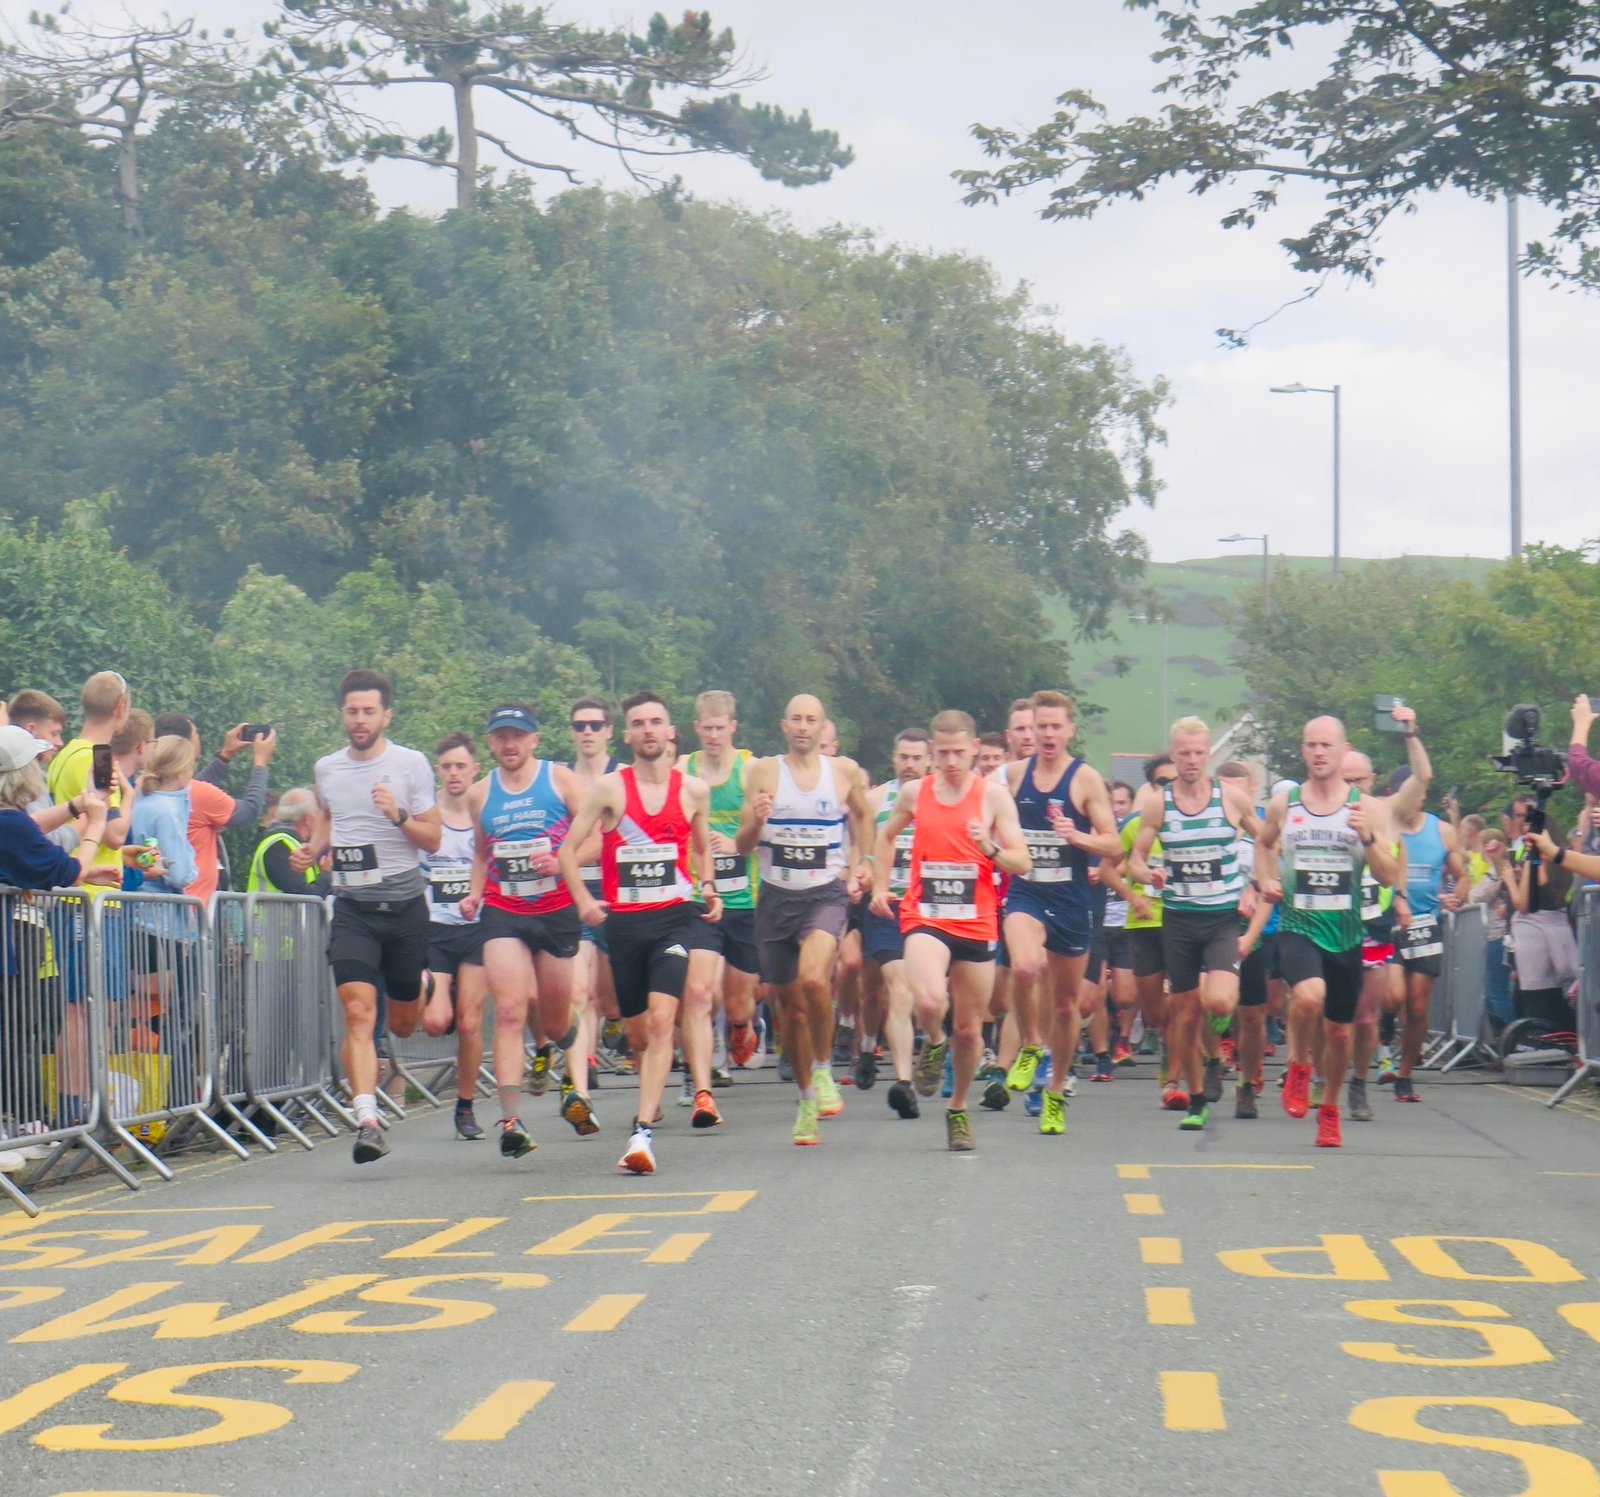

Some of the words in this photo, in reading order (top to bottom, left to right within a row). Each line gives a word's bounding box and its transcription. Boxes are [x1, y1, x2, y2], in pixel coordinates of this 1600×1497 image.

[336, 848, 364, 862] 410
[783, 847, 816, 860] 545
[1029, 846, 1060, 860] 346
[630, 863, 666, 878] 446
[714, 858, 736, 871] 89
[1181, 862, 1212, 875] 442
[1307, 872, 1340, 887] 232
[441, 882, 471, 895] 492
[932, 880, 965, 895] 140
